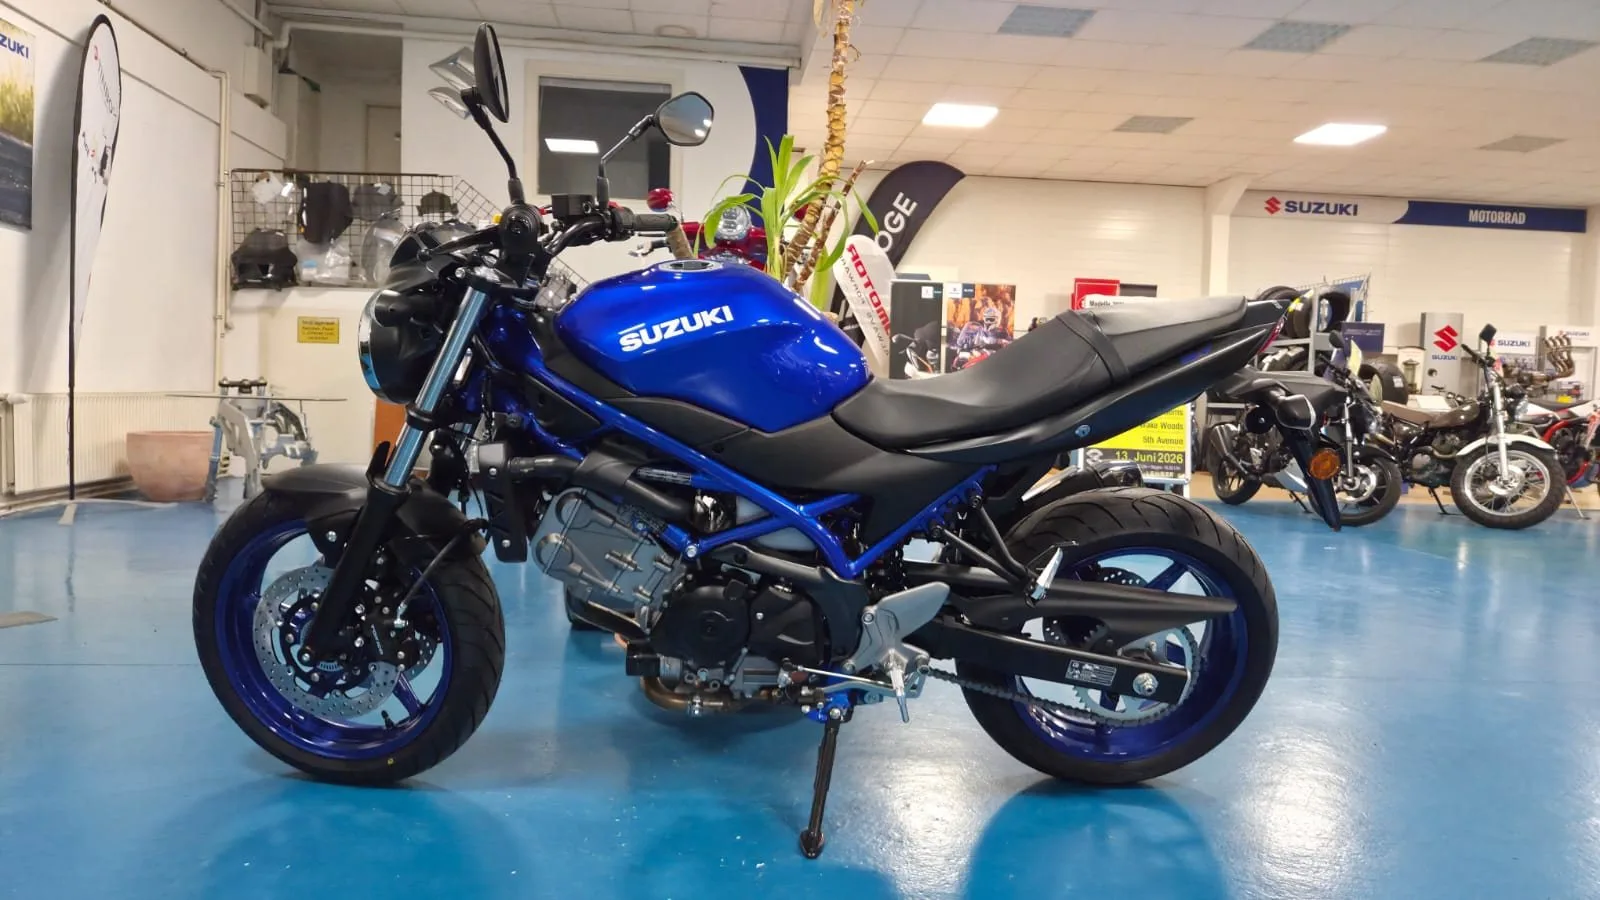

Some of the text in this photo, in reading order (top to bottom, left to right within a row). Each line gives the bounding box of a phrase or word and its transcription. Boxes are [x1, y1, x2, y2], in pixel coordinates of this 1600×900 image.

[1284, 200, 1526, 224] SUZUKI MOTORRAD
[618, 305, 734, 352] SUZUKI
[1157, 437, 1184, 446] Avenue
[1135, 452, 1156, 463] Juni
[1158, 453, 1183, 464] 2026
